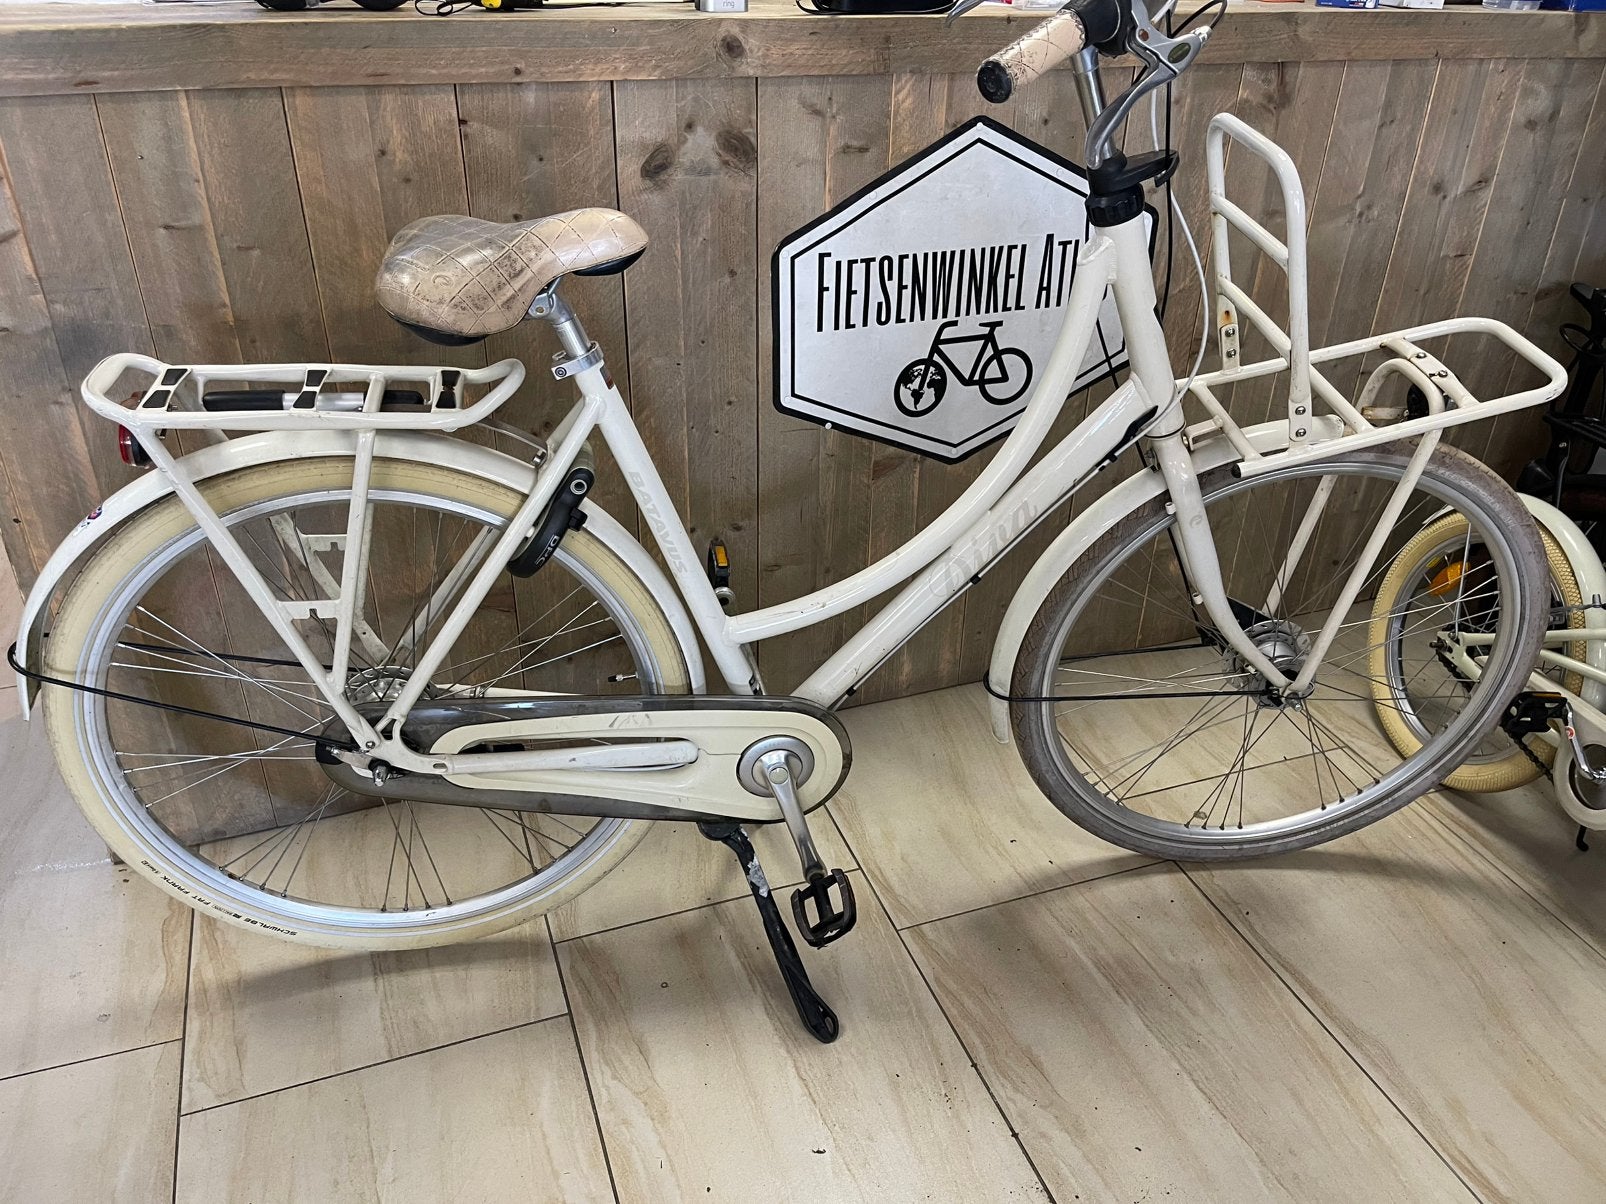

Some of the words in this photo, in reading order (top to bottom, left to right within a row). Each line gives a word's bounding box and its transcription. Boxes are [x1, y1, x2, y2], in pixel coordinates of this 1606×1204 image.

[816, 243, 1027, 333] FIETSENWINKEL
[628, 471, 688, 573] BATAVUS
[244, 918, 297, 935] SCHWALBE
